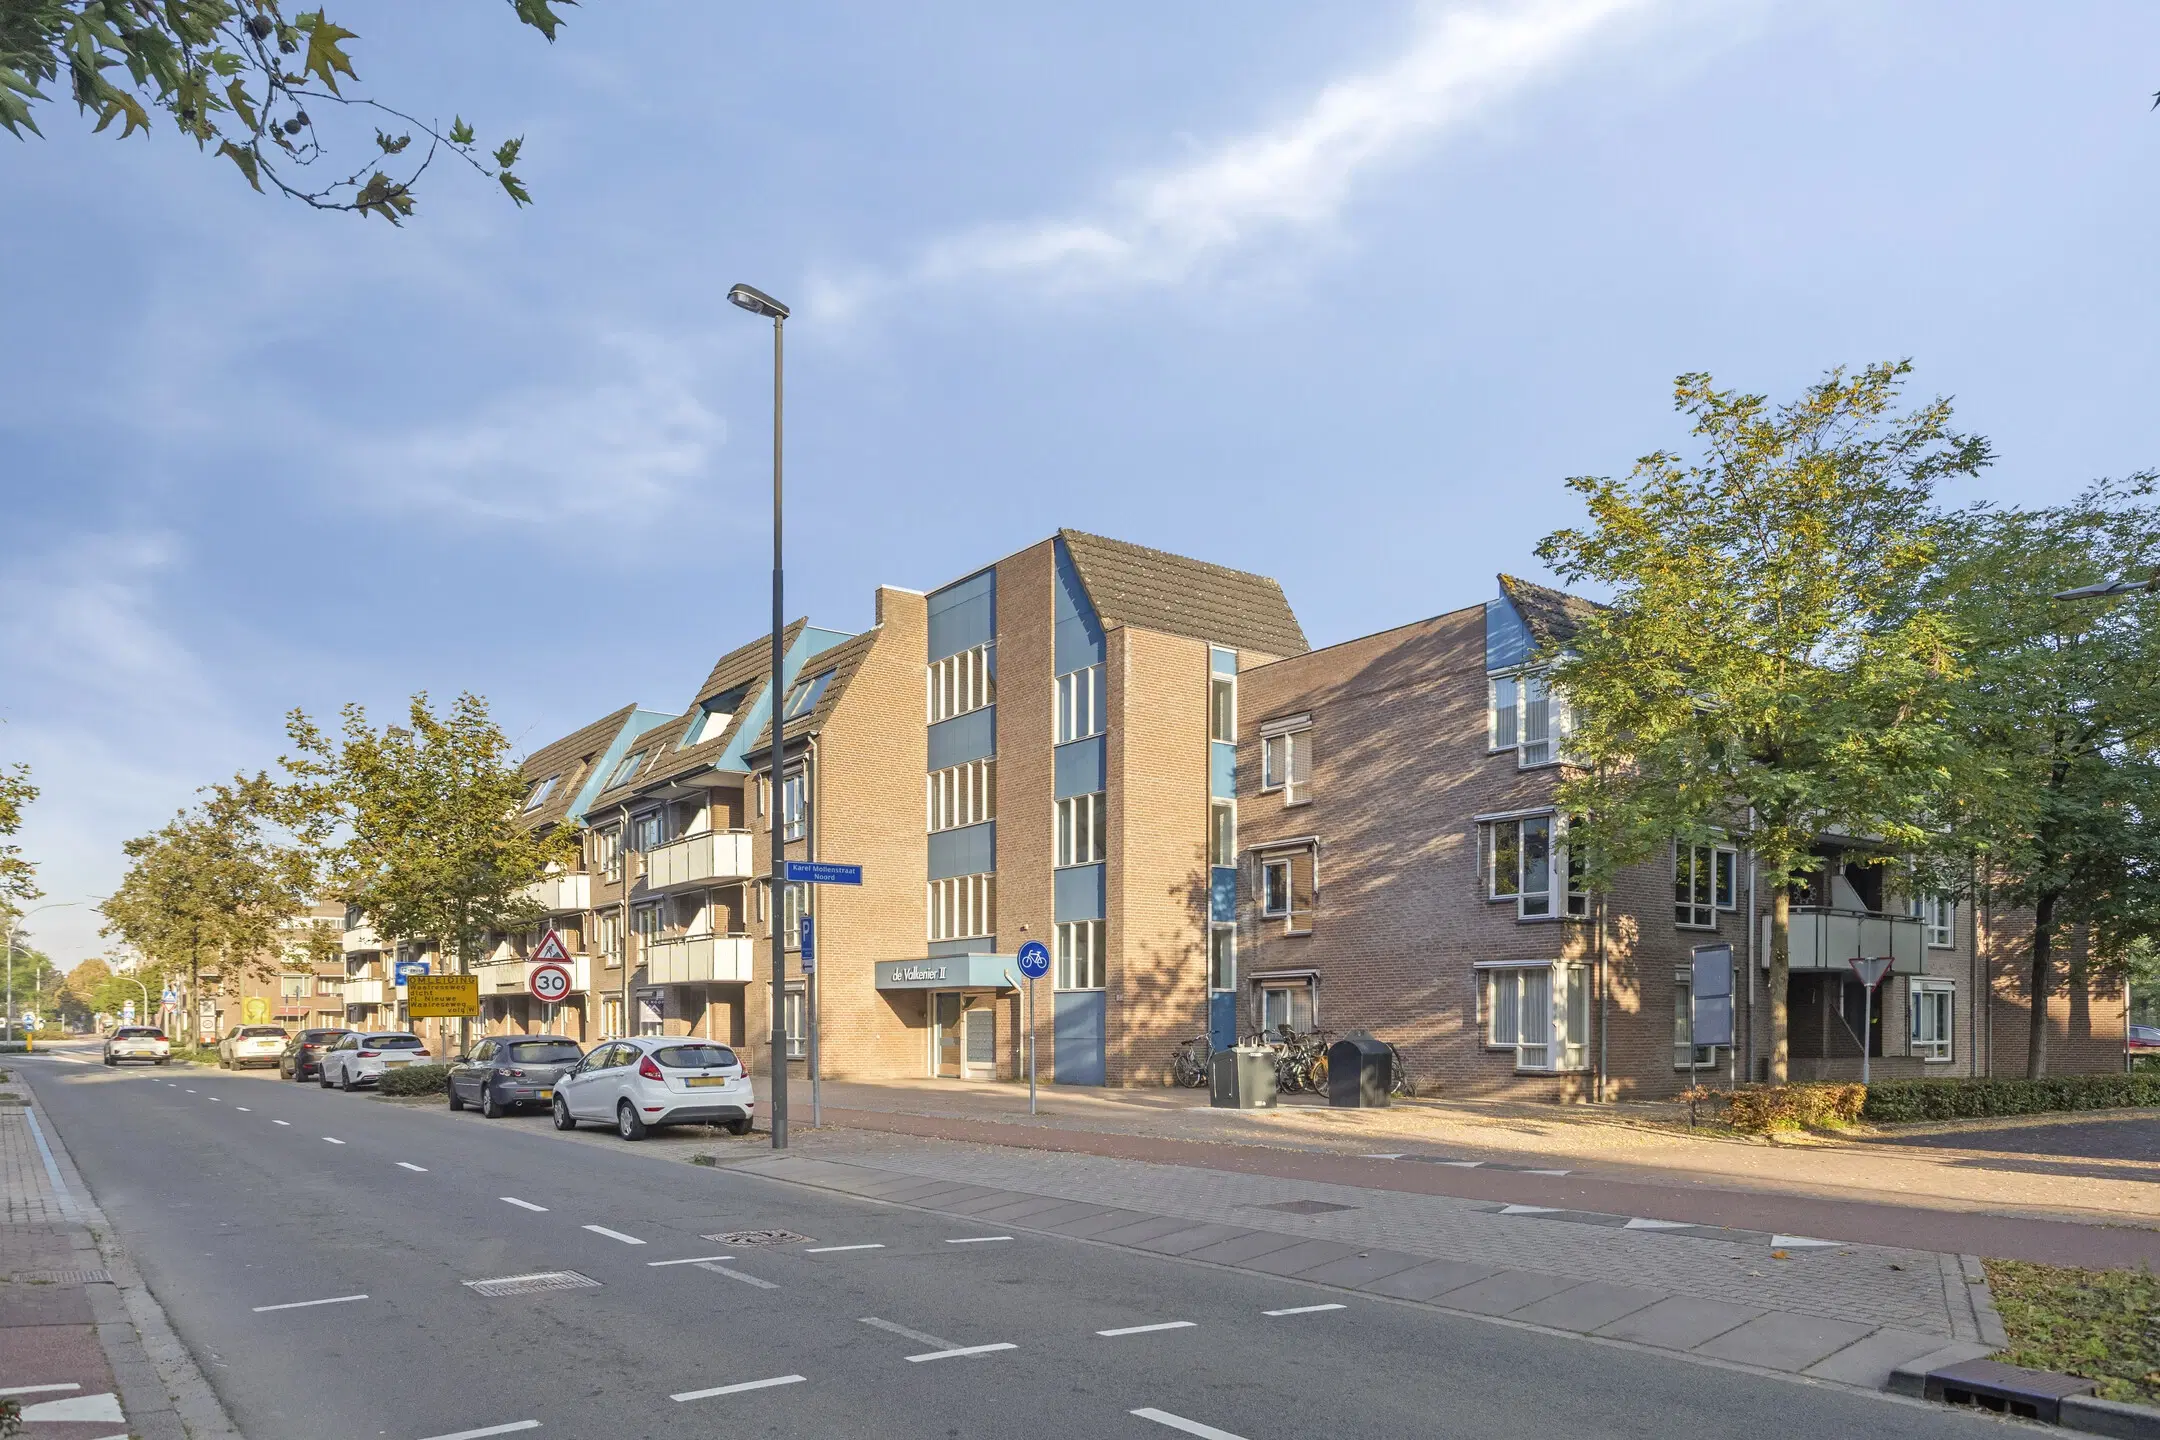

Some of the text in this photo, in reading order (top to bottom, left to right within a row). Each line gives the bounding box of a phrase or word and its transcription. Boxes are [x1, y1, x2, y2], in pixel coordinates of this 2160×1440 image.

[792, 864, 811, 872] Karel
[814, 873, 836, 881] Noord
[802, 920, 810, 942] P
[892, 967, 902, 981] de
[903, 965, 938, 981] Valkenier
[409, 976, 476, 984] OMLEIDING
[537, 975, 565, 991] 30
